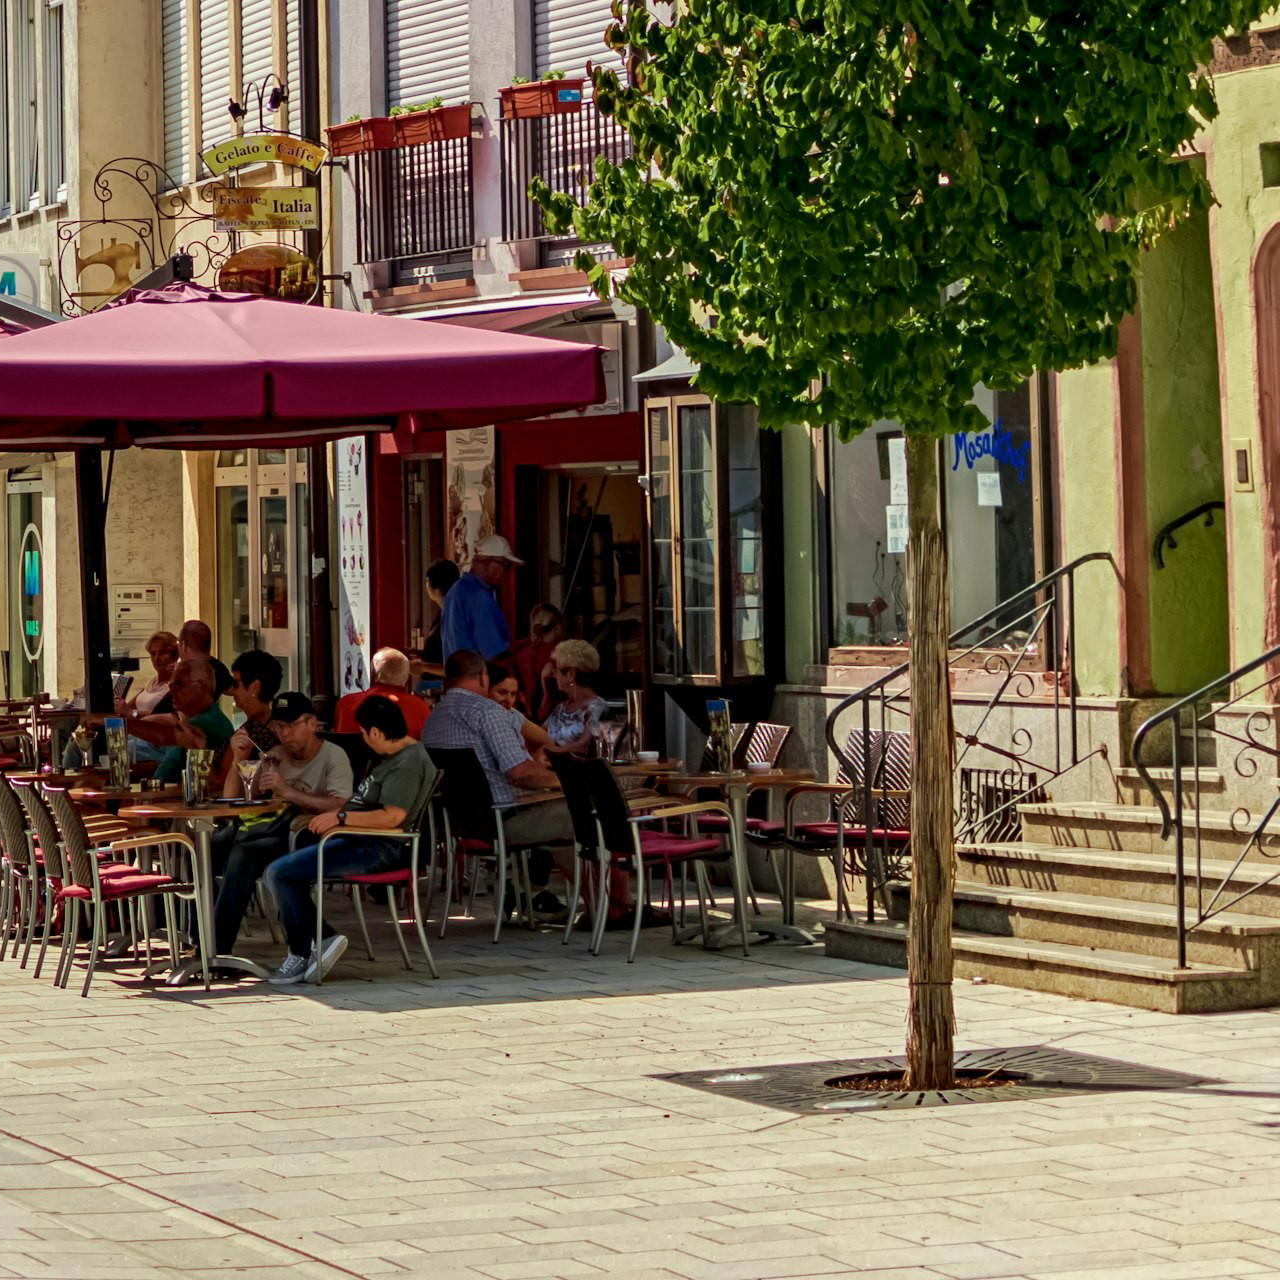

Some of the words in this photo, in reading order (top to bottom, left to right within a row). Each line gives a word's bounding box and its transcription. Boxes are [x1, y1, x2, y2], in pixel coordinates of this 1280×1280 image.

[216, 144, 260, 164] Gelato
[265, 145, 272, 153] e
[273, 200, 312, 213] Italia
